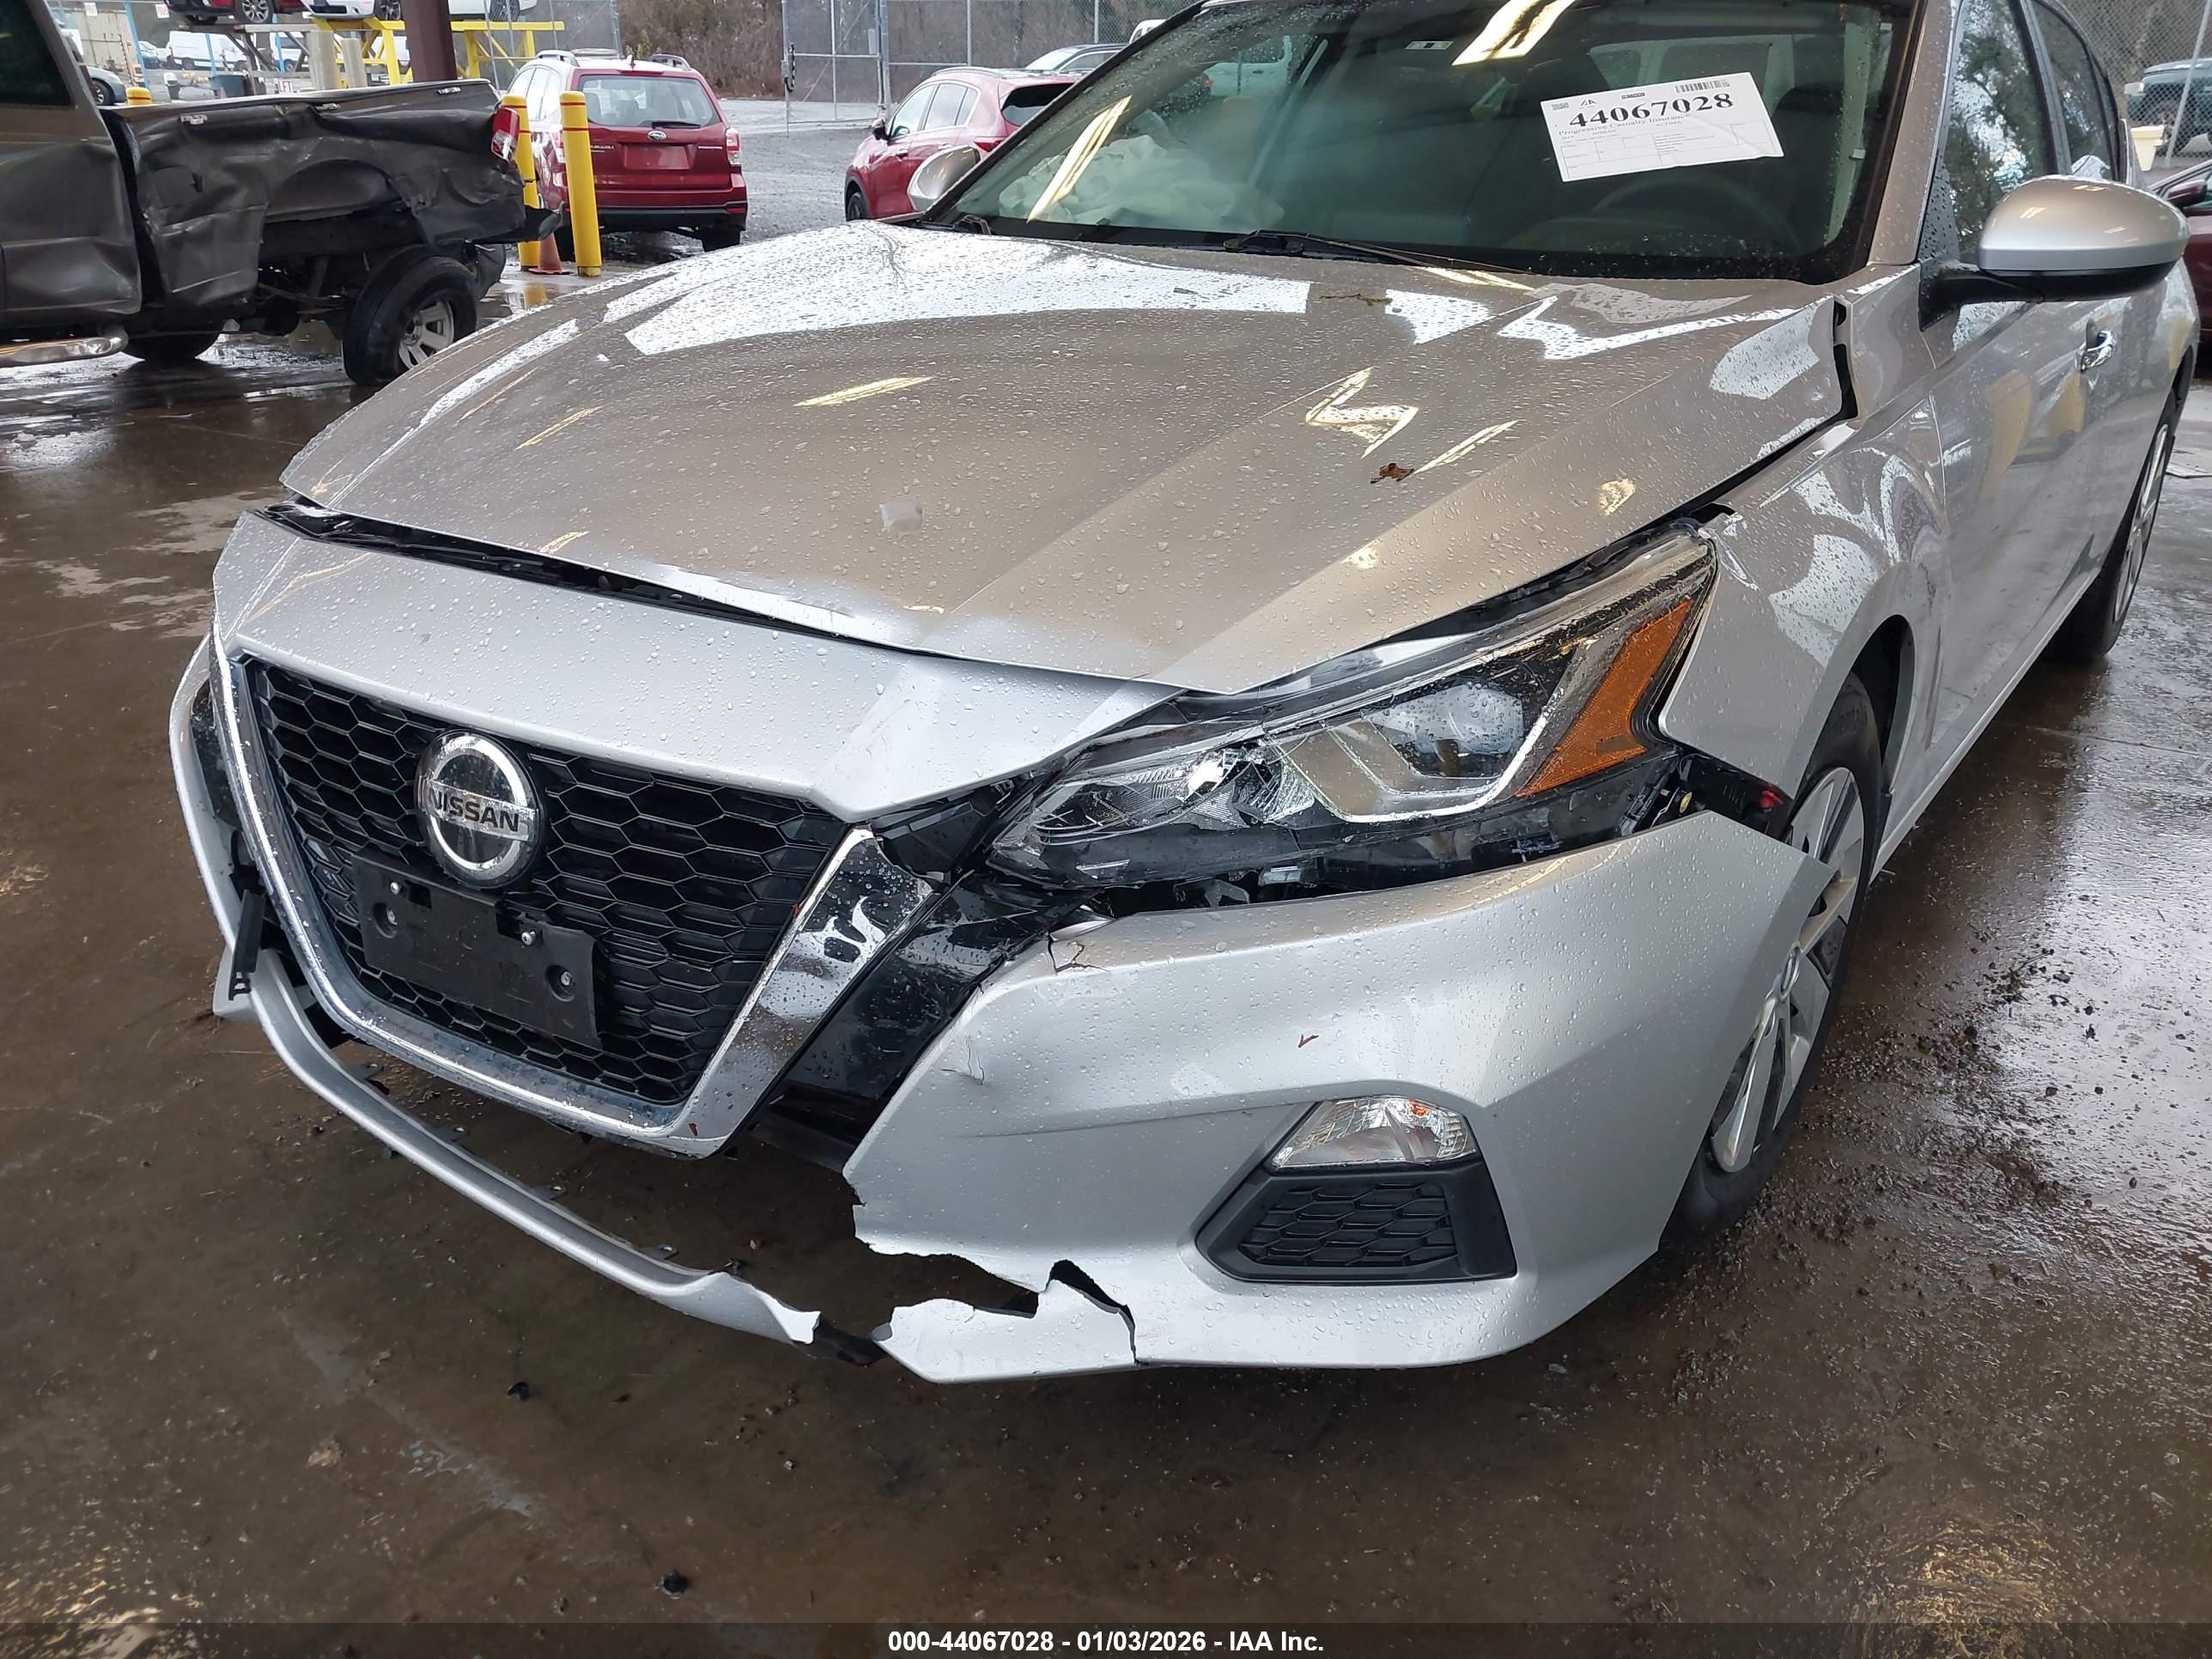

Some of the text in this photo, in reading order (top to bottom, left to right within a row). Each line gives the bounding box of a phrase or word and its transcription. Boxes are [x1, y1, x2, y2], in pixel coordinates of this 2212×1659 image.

[1559, 112, 1692, 136] Progressive Casualty Insurance
[1569, 93, 1734, 127] 44067028
[432, 787, 520, 832] NISSAN
